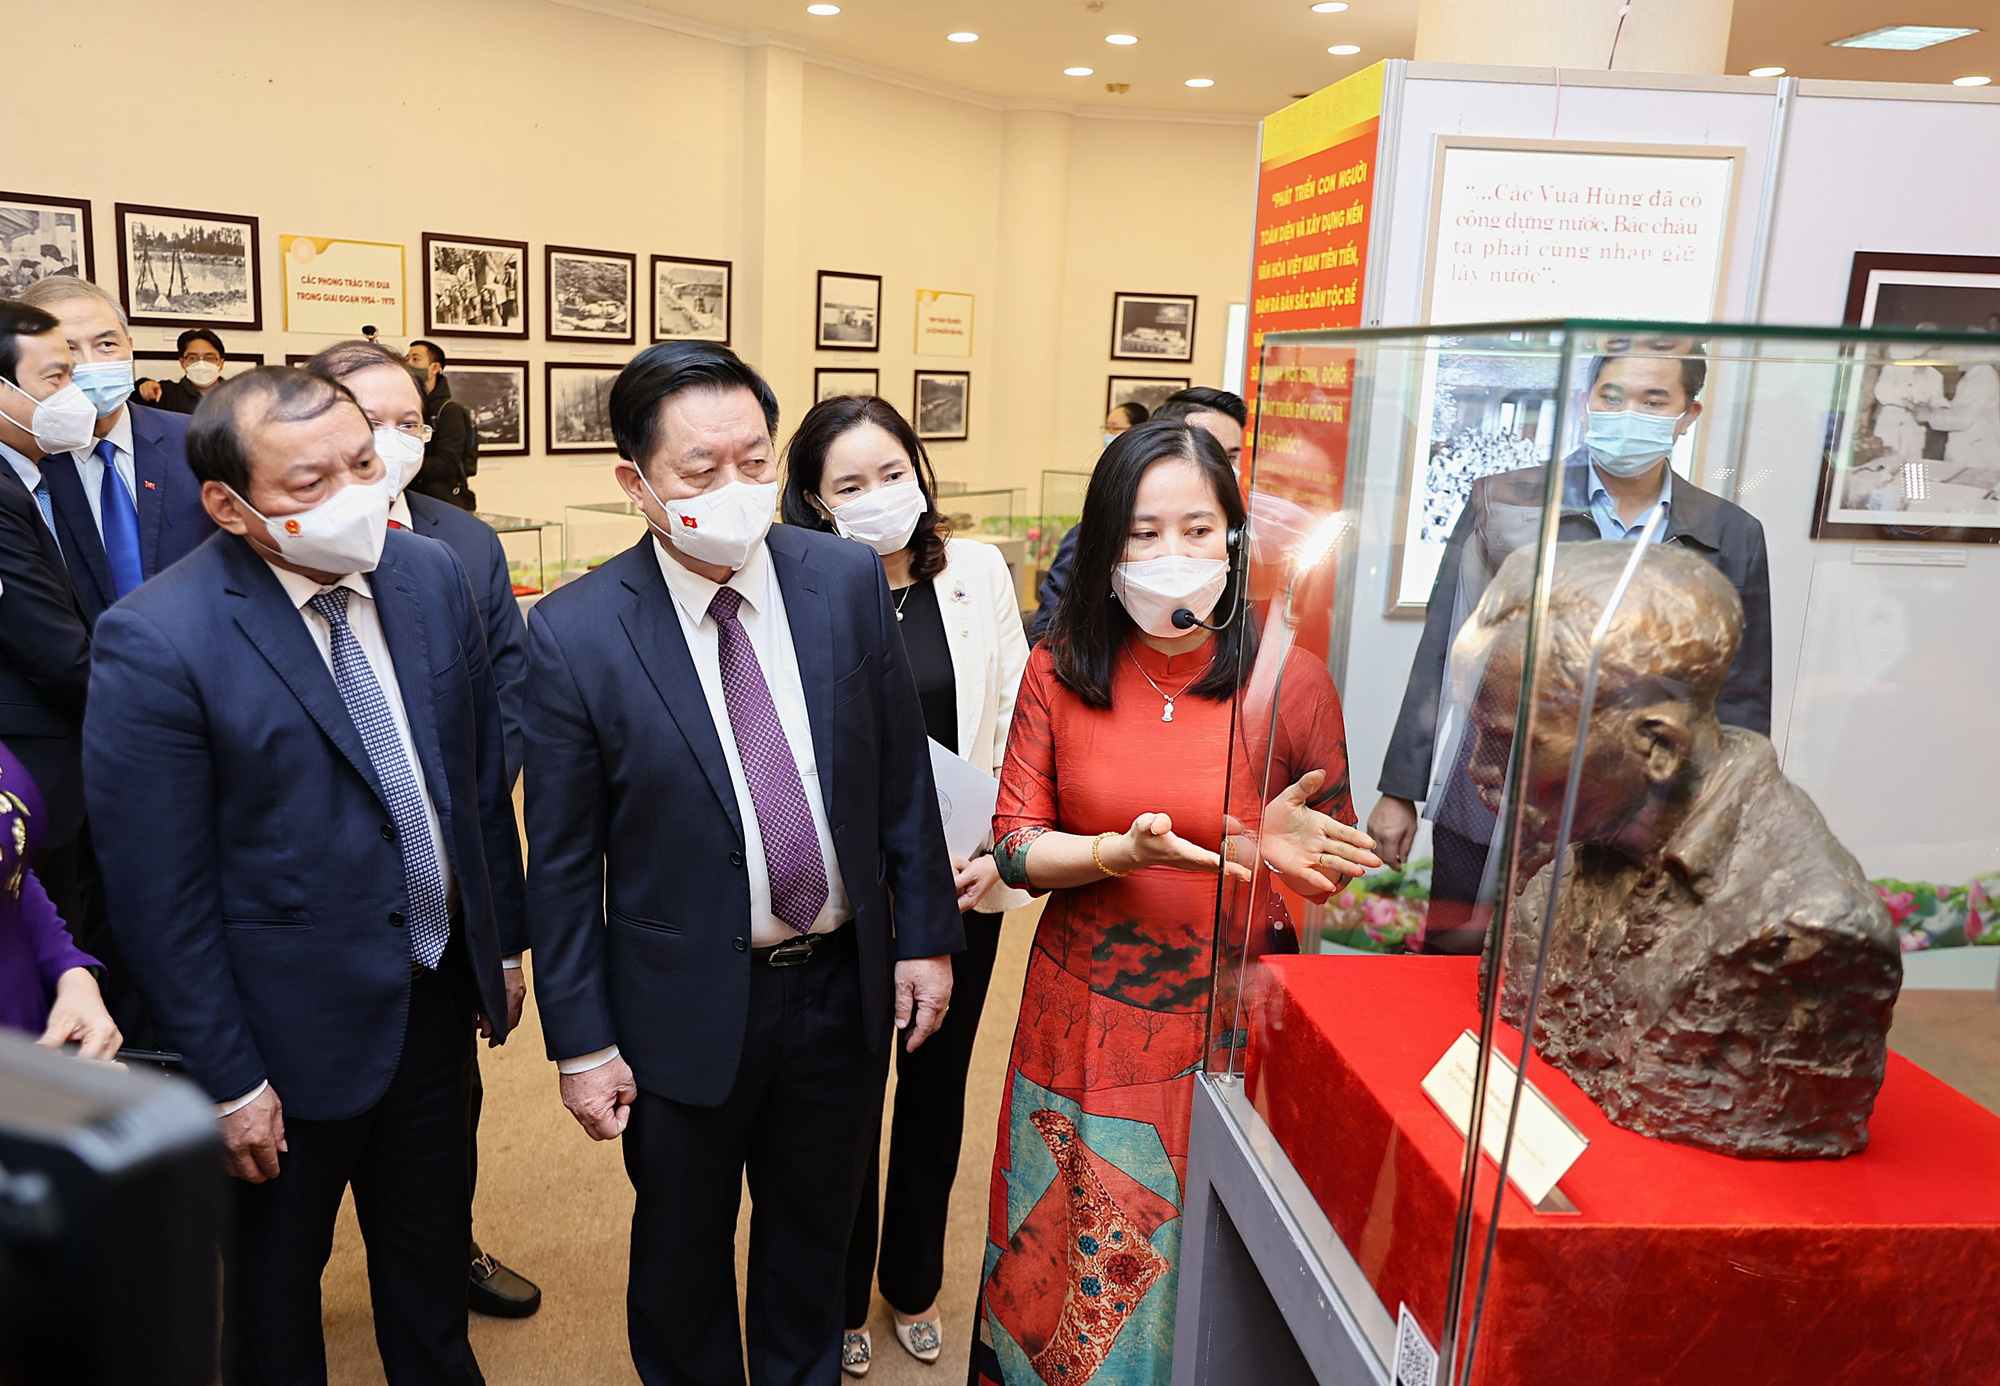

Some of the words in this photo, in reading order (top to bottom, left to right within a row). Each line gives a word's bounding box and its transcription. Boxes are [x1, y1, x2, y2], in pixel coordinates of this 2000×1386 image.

[1318, 173, 1336, 195] CON
[1338, 160, 1368, 189] NGƯỜI
[1540, 185, 1579, 203] Vua
[1587, 186, 1644, 209] Hùng
[1649, 189, 1673, 207] đã
[1679, 191, 1702, 208] có
[1456, 209, 1502, 231] công
[1614, 214, 1648, 233] Bác
[1652, 216, 1698, 235] cháu
[1454, 241, 1472, 254] ta
[1600, 242, 1652, 260] nhau
[1287, 254, 1303, 280] VIỆT
[1302, 253, 1320, 273] NAM
[301, 274, 316, 285] CÁC
[318, 277, 343, 287] PHONG
[345, 277, 362, 288] TRÀO
[364, 280, 375, 288] THI
[376, 281, 390, 289] ĐUA
[296, 292, 322, 301] TRONG
[323, 293, 338, 302] GIAI
[340, 295, 359, 306] ĐOẠN
[361, 296, 375, 304] 1954
[381, 297, 395, 305] 1975
[1295, 285, 1309, 310] SẮC
[1327, 284, 1343, 312] TỘC
